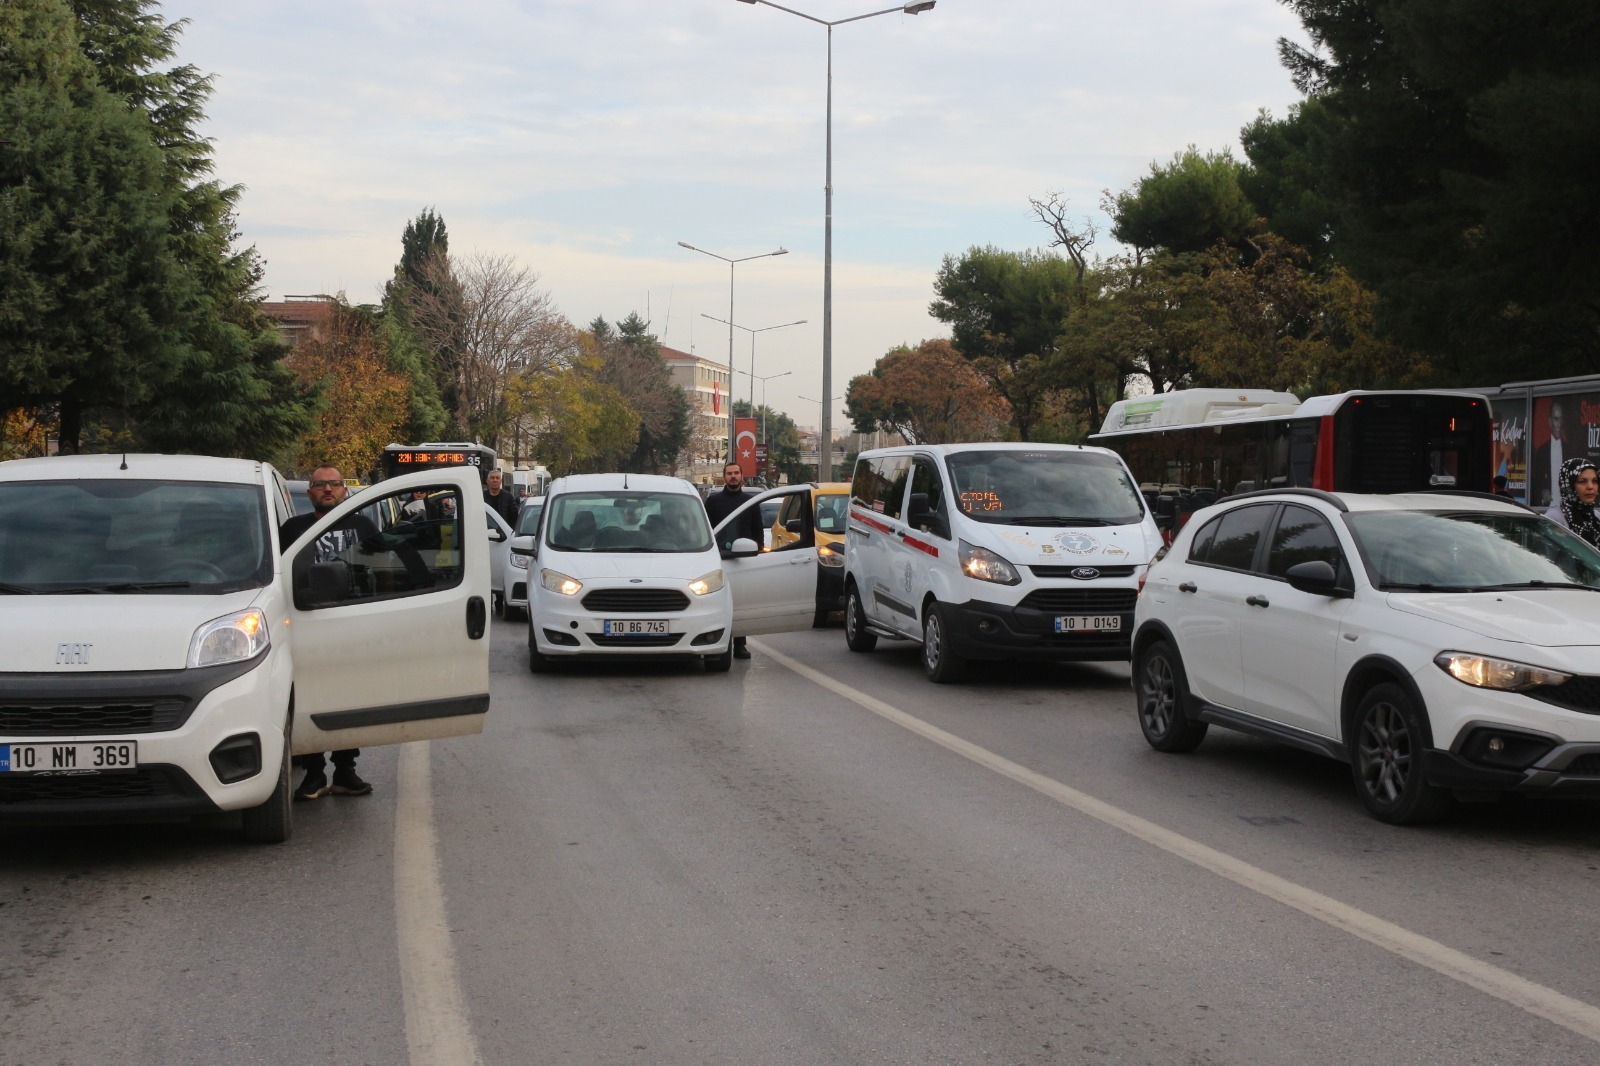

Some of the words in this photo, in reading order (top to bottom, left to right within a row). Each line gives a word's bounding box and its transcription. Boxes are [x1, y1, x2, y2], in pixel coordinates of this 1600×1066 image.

[467, 456, 481, 466] 35
[1077, 568, 1094, 576] Ford
[613, 622, 624, 632] 10
[629, 622, 642, 632] BG
[647, 622, 664, 632] 745
[1063, 617, 1075, 629] 10
[1082, 617, 1088, 629] T
[1094, 617, 1118, 629] 0149
[55, 642, 93, 665] FIAT
[12, 746, 36, 768] 10
[52, 746, 77, 768] NM
[92, 745, 130, 767] 369
